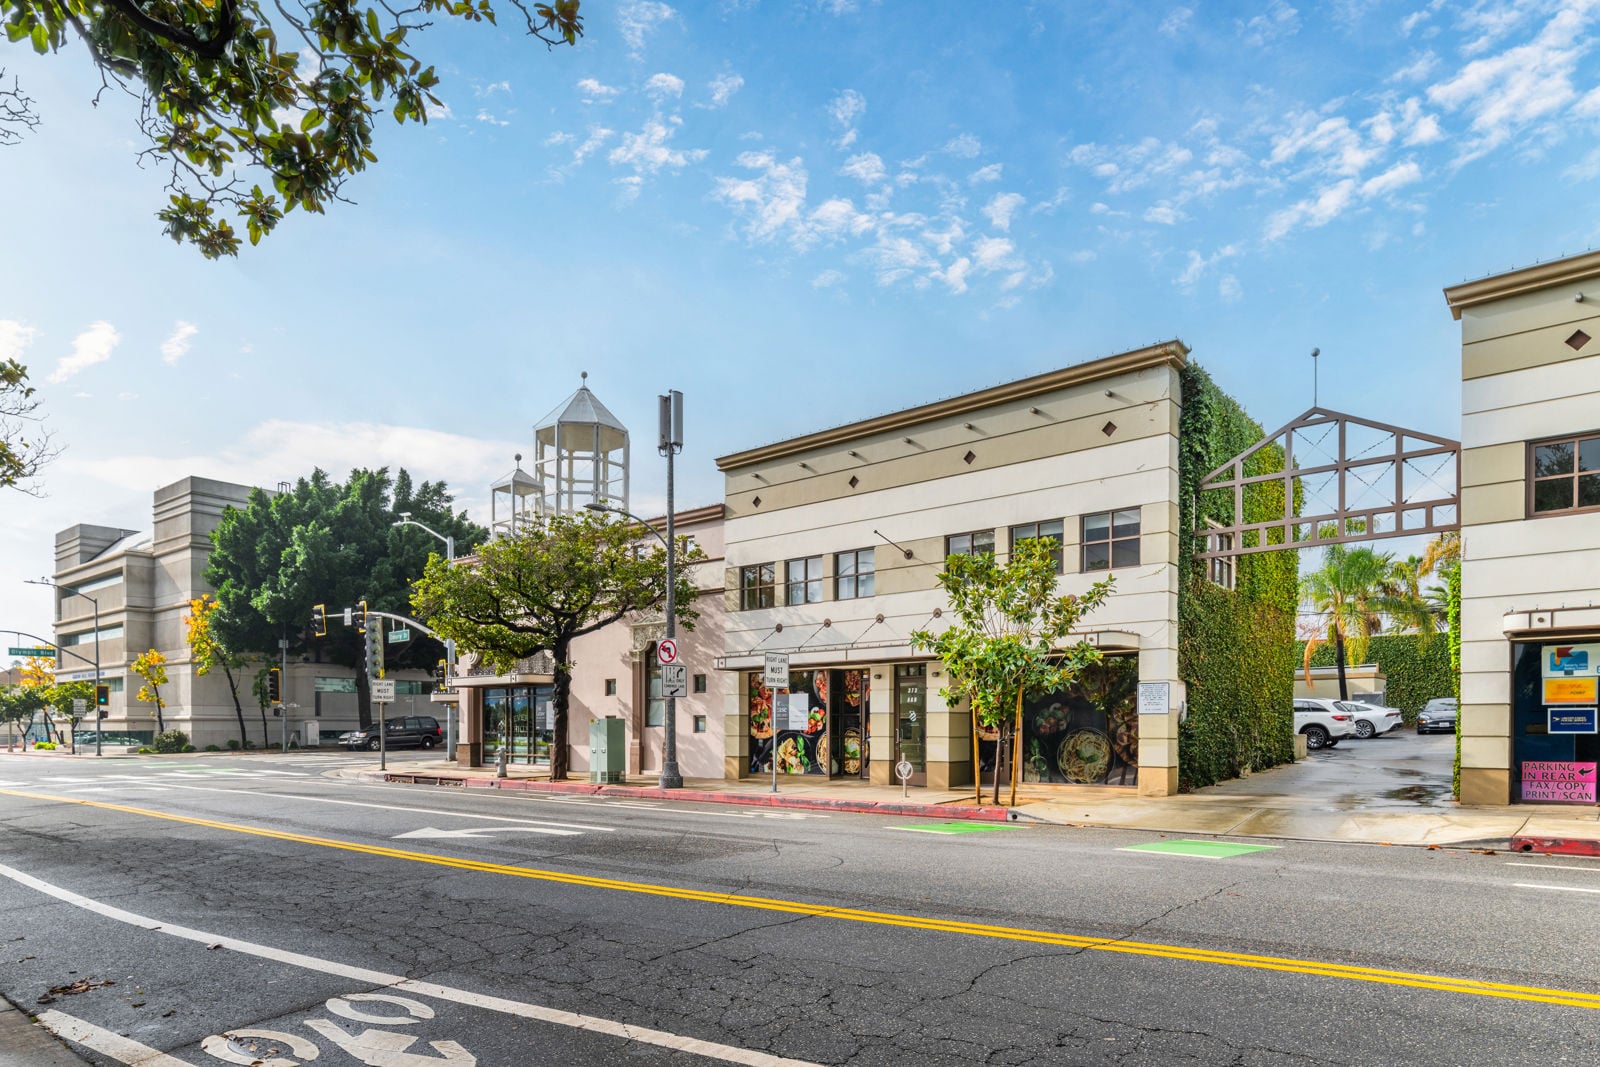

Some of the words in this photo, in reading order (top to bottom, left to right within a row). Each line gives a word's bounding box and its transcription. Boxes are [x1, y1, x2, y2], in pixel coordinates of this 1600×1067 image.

[1524, 763, 1574, 771] PARKING
[1530, 781, 1586, 790] FAX/COPY
[1526, 791, 1591, 800] PRINT/SCAN
